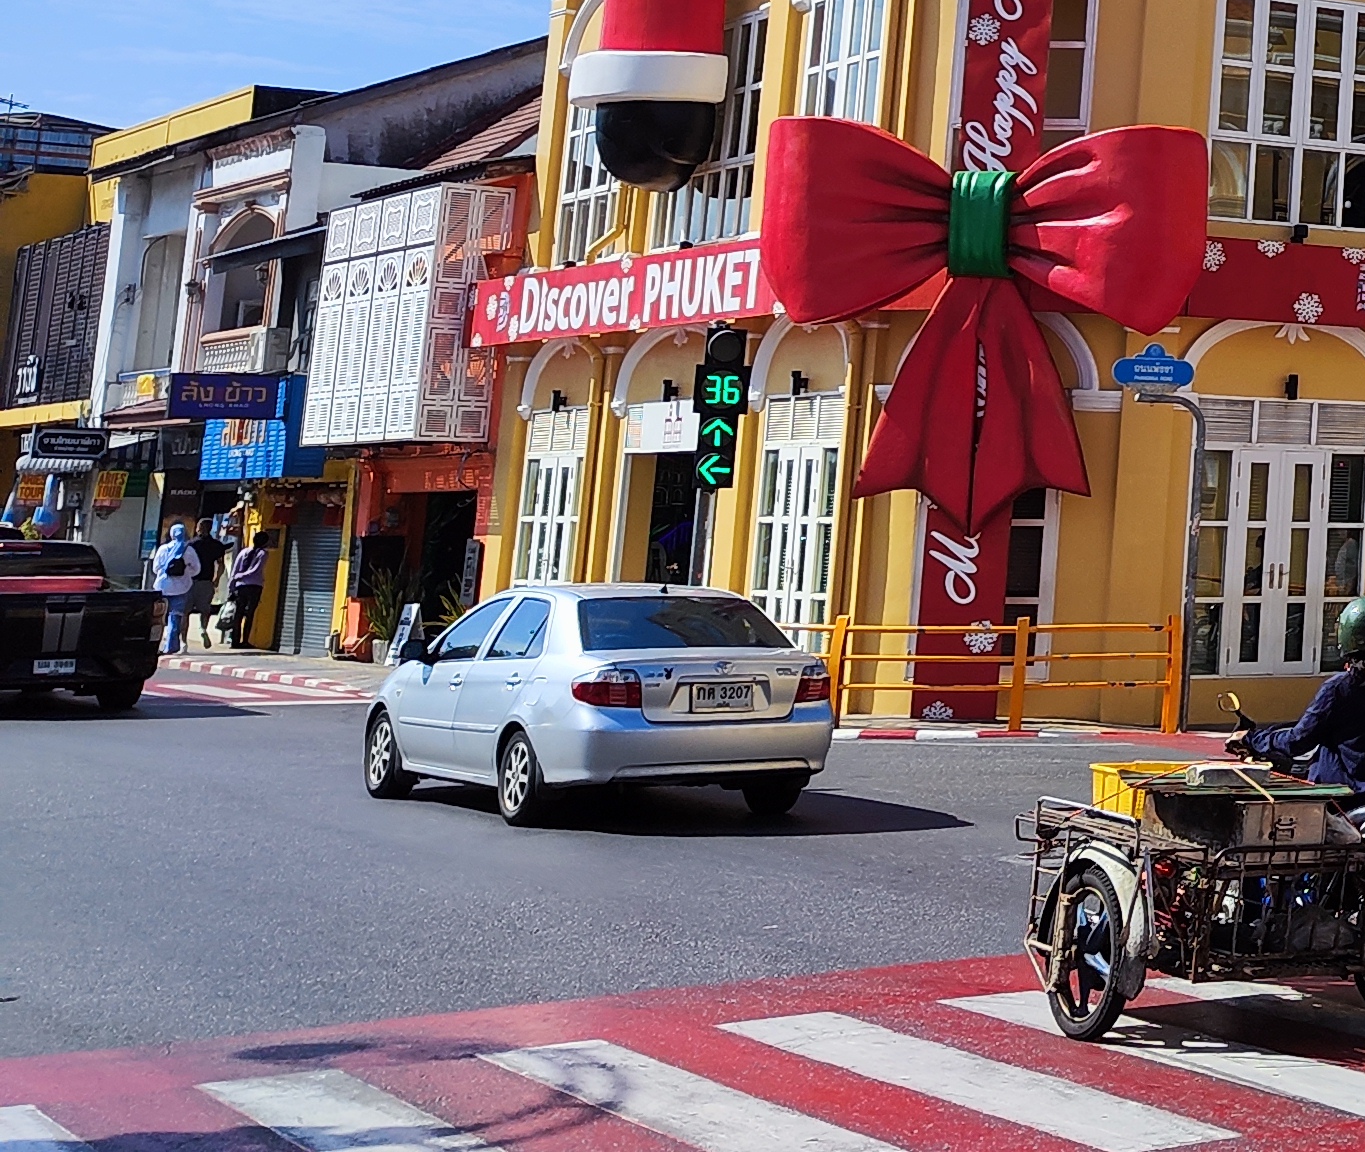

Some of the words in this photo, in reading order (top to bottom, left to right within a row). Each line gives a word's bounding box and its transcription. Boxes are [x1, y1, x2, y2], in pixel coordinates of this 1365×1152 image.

[963, 37, 1038, 172] Happy
[519, 273, 634, 335] Discover
[642, 249, 760, 323] PHUKET
[705, 375, 740, 404] 36
[720, 686, 750, 700] 3207
